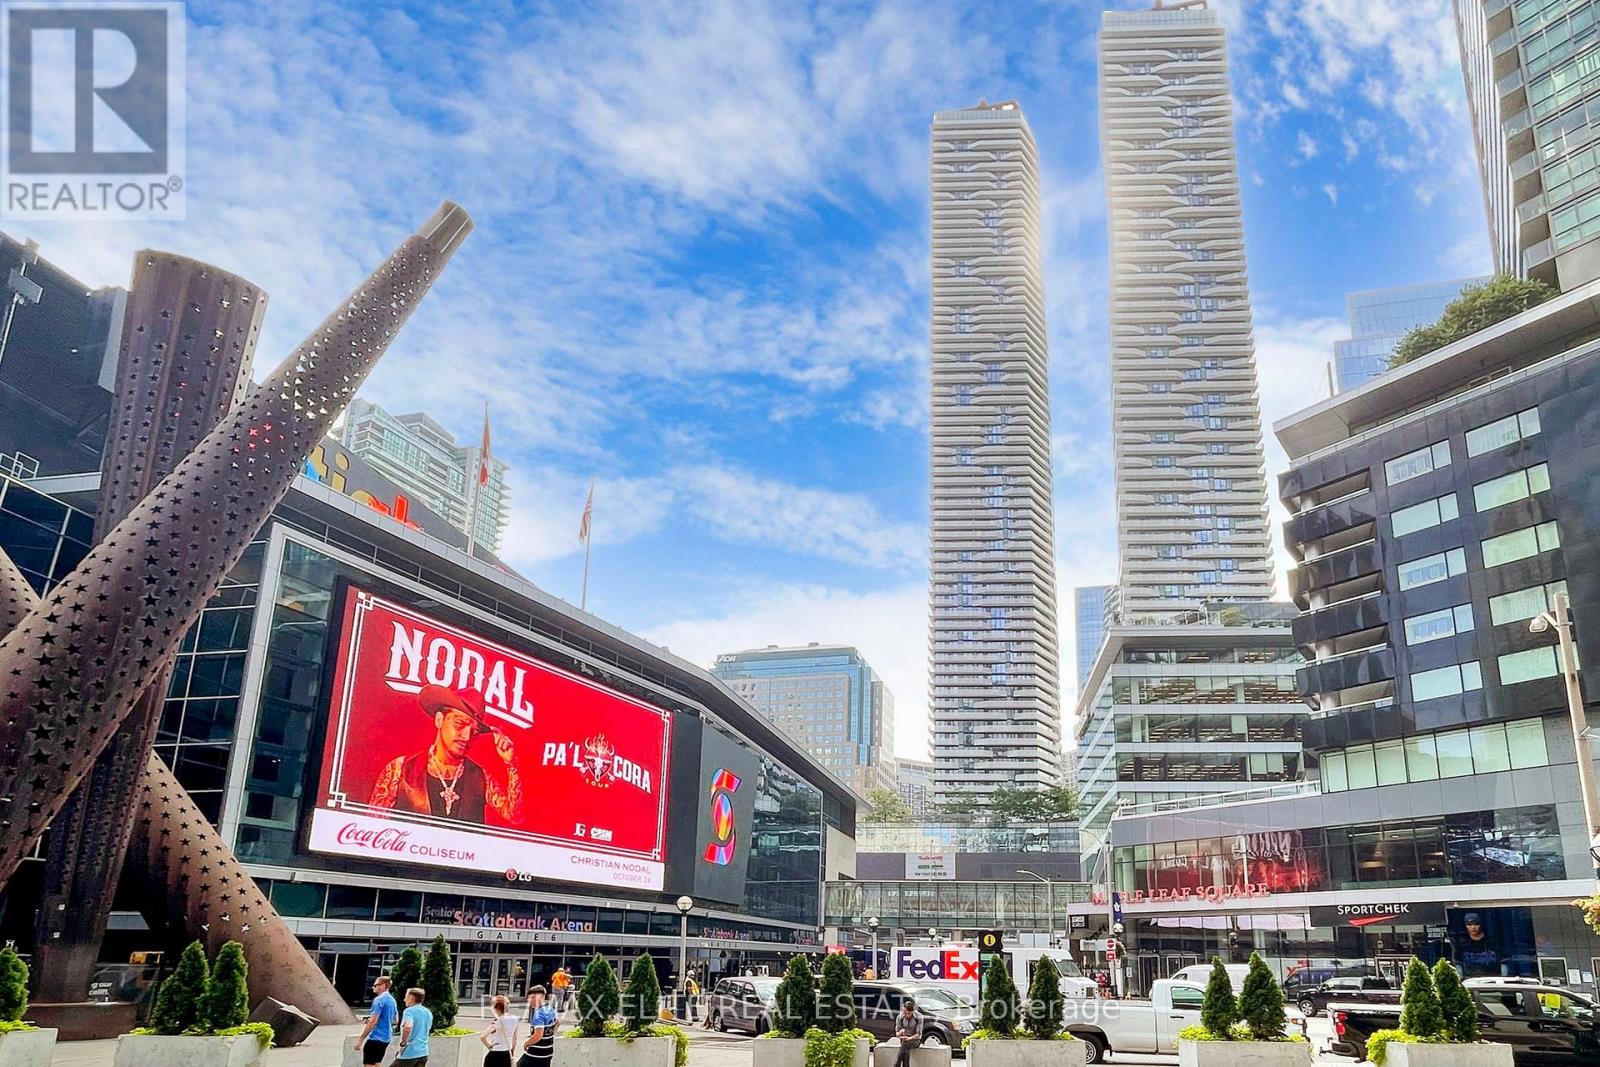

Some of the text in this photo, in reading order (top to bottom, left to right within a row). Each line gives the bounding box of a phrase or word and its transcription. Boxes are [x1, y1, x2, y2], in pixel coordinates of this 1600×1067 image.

[384, 620, 535, 724] NODAL
[541, 741, 652, 794] PA'L CORA
[585, 778, 610, 789] TOUR
[409, 844, 476, 862] COLISEUM
[570, 855, 652, 874] CHRISTIAN NODAL
[518, 871, 532, 882] LG
[613, 872, 642, 883] OCTOBER
[1149, 886, 1192, 903] LEAF
[1195, 882, 1271, 904] SQUARE
[1337, 903, 1410, 915] SPORTCHEK
[453, 909, 593, 933] Scotiabank Arena
[551, 934, 557, 942] 6
[896, 949, 980, 980] FedEx
